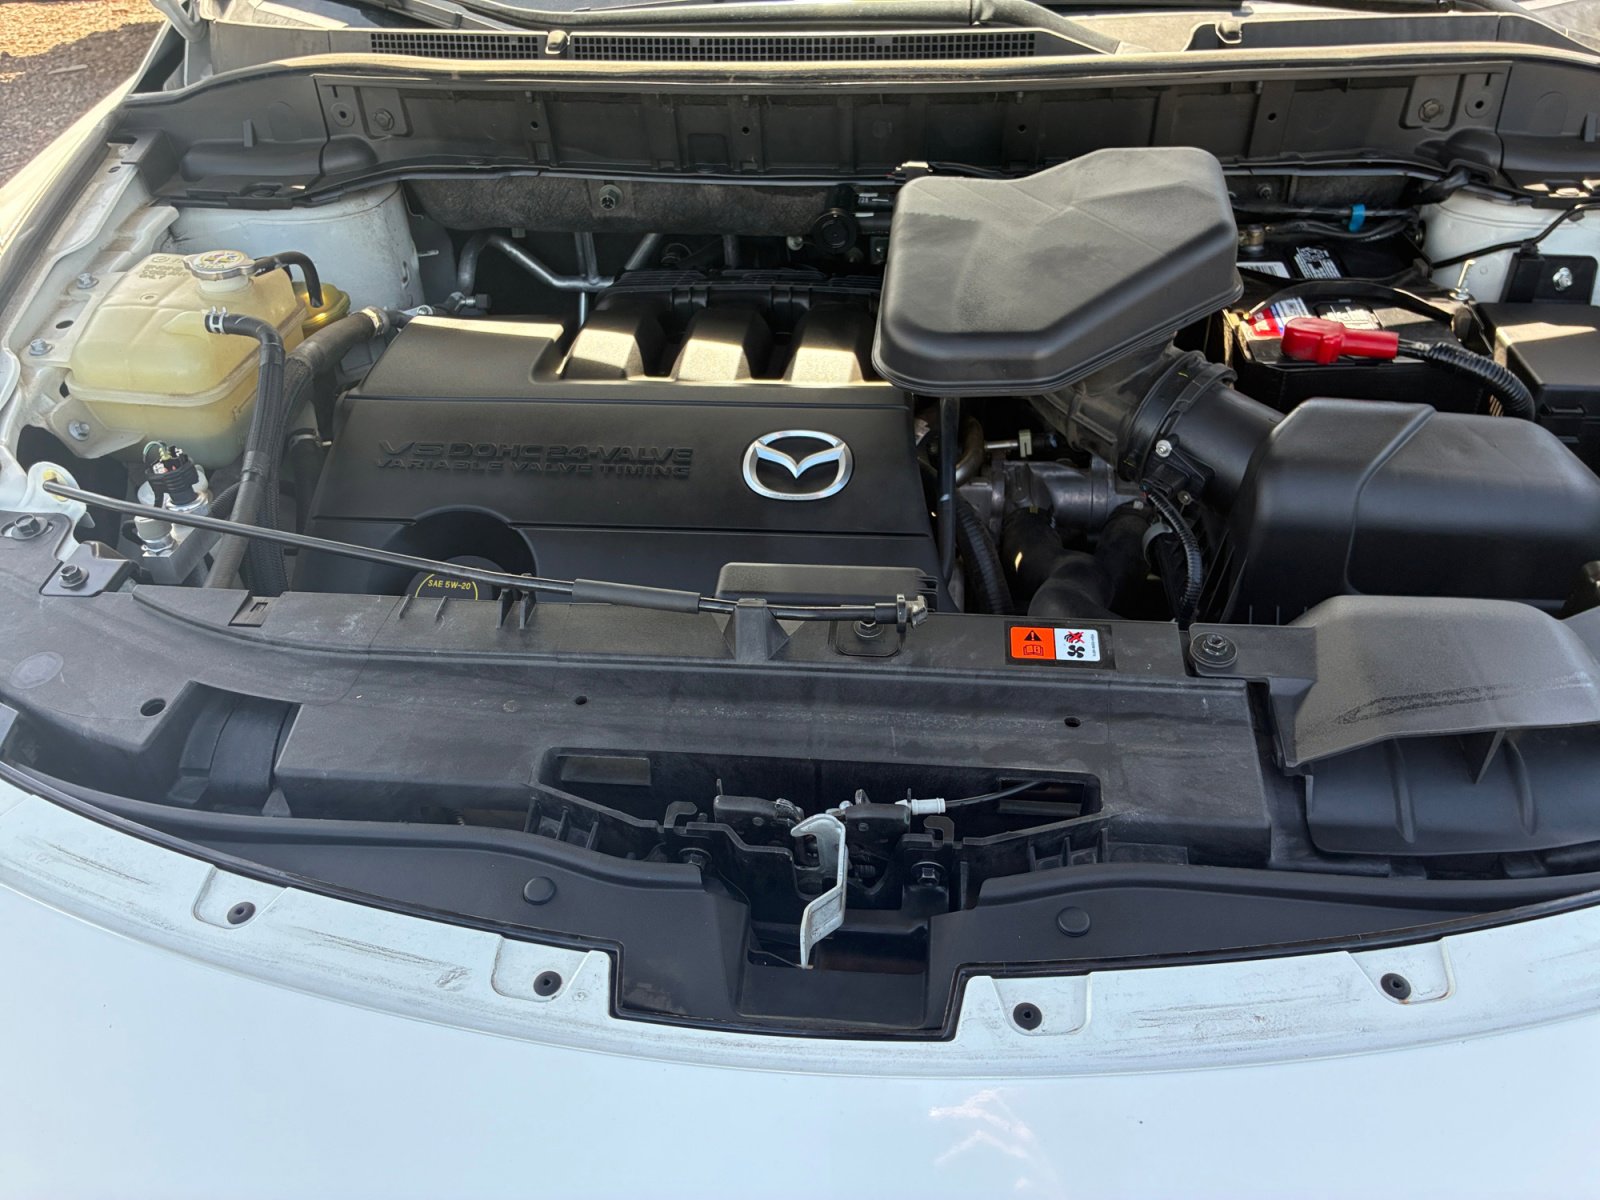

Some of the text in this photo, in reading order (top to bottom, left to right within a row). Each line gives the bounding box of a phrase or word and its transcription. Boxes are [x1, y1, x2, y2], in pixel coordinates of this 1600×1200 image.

[448, 441, 544, 459] DOHC
[546, 443, 694, 464] 24-VALVE
[376, 459, 691, 479] VARIABLE VALVE TIMING
[427, 579, 471, 590] SAE 5W-20
